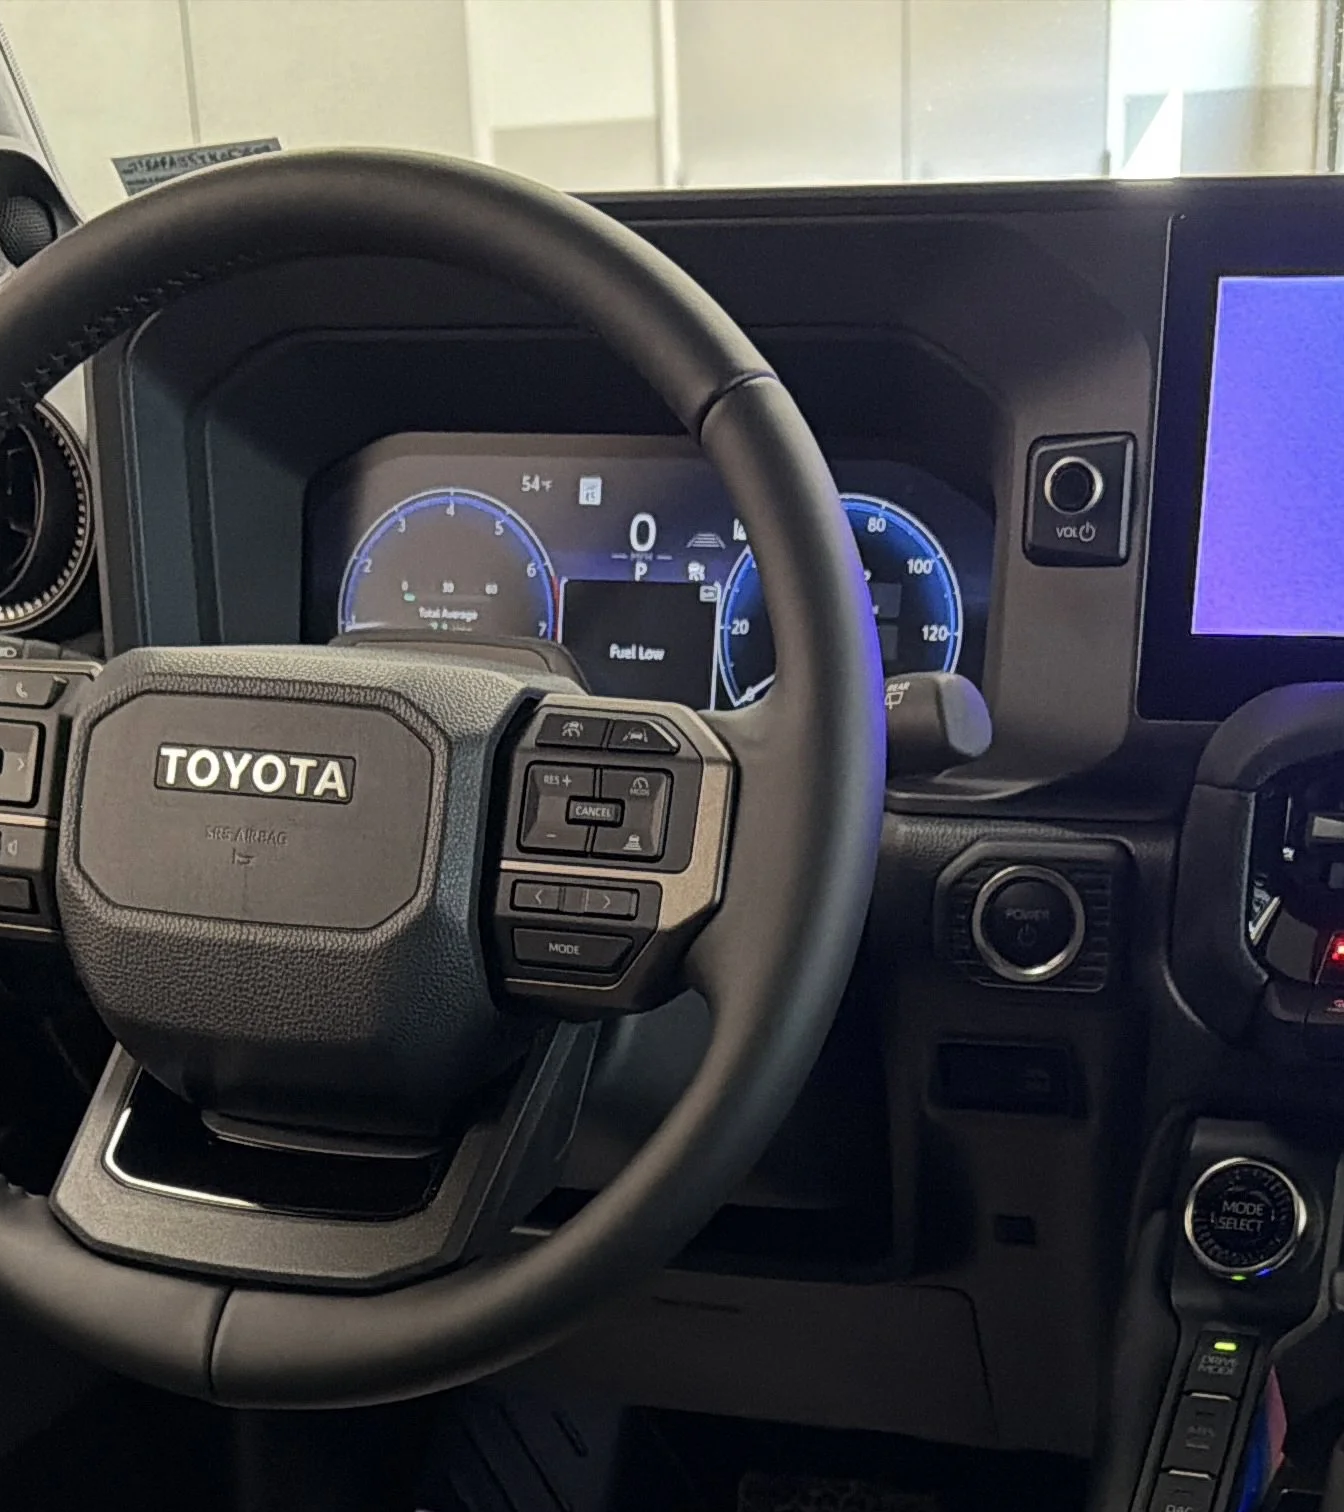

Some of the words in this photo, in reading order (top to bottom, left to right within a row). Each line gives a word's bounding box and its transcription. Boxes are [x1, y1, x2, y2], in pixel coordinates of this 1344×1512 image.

[446, 502, 456, 517] 4
[397, 518, 407, 534] 3
[494, 519, 505, 535] 5
[629, 512, 657, 552] 0
[866, 516, 887, 533] 80
[1056, 526, 1078, 540] VOL
[362, 558, 374, 573] 2
[525, 562, 538, 578] 6
[635, 561, 648, 582] P
[906, 558, 934, 575] 100
[538, 621, 548, 637] 7
[731, 619, 750, 636] 20
[921, 625, 949, 642] 120
[610, 643, 637, 661] Fuel
[638, 645, 665, 661] Low
[159, 747, 349, 798] TOYOTA
[543, 774, 560, 786] RES
[575, 805, 613, 820] CANCEL
[548, 943, 580, 956] MODE
[1222, 1200, 1265, 1217] MODE
[1215, 1216, 1264, 1232] SELECT
